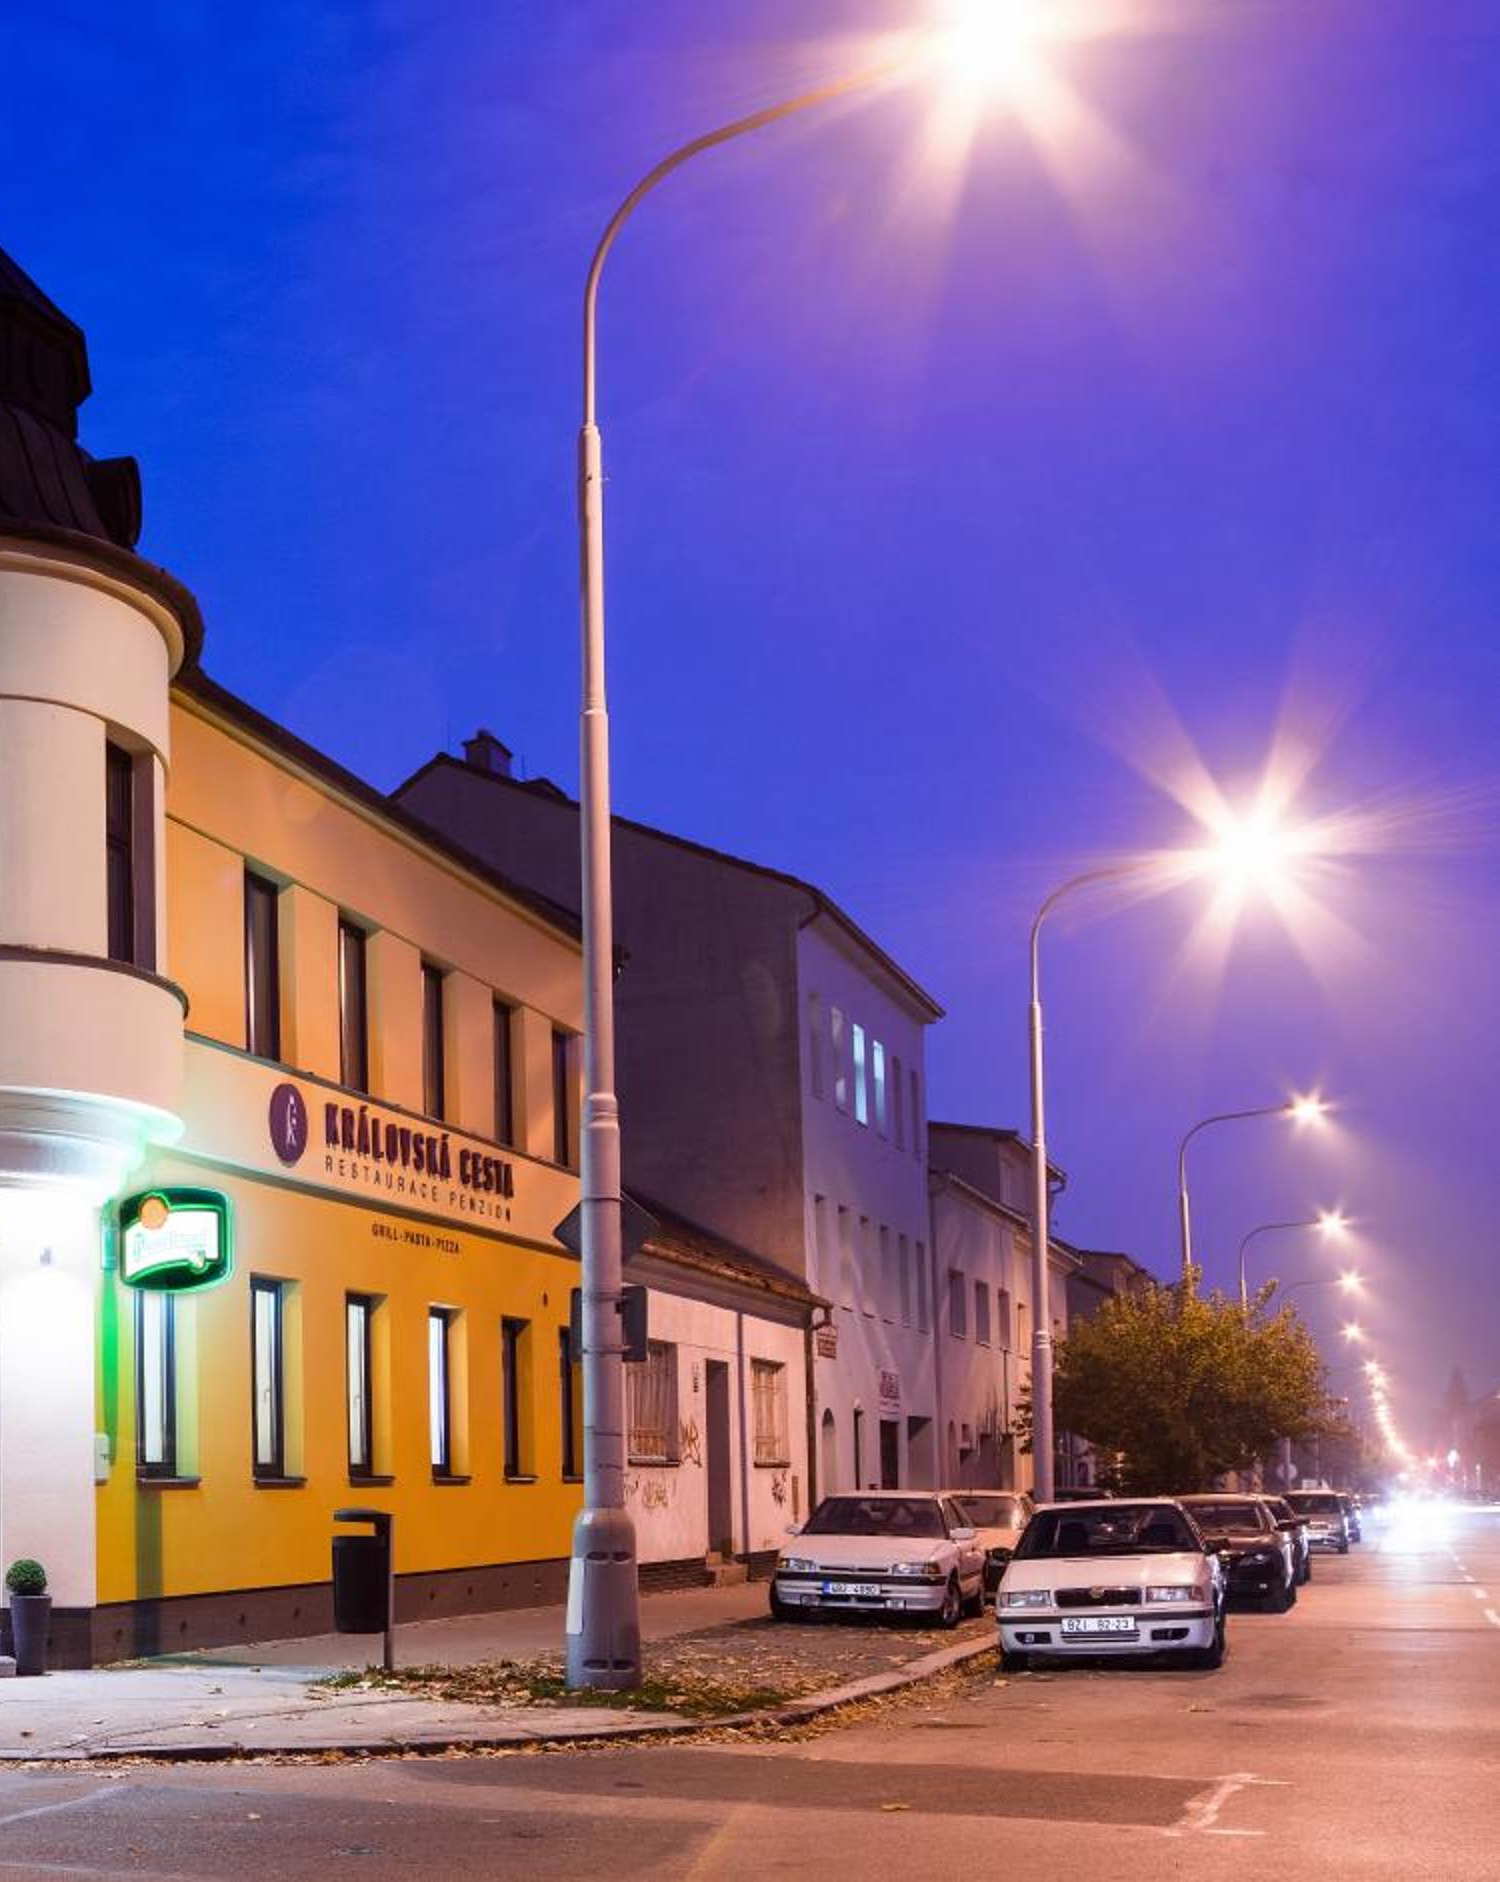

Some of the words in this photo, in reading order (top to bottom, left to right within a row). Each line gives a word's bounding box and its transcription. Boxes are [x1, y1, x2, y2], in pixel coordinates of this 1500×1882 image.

[325, 1102, 452, 1180] KRÁLOVSKÁ
[459, 1149, 515, 1200] CESTA
[325, 1155, 439, 1202] RESTAURACE
[449, 1191, 512, 1222] PENZION
